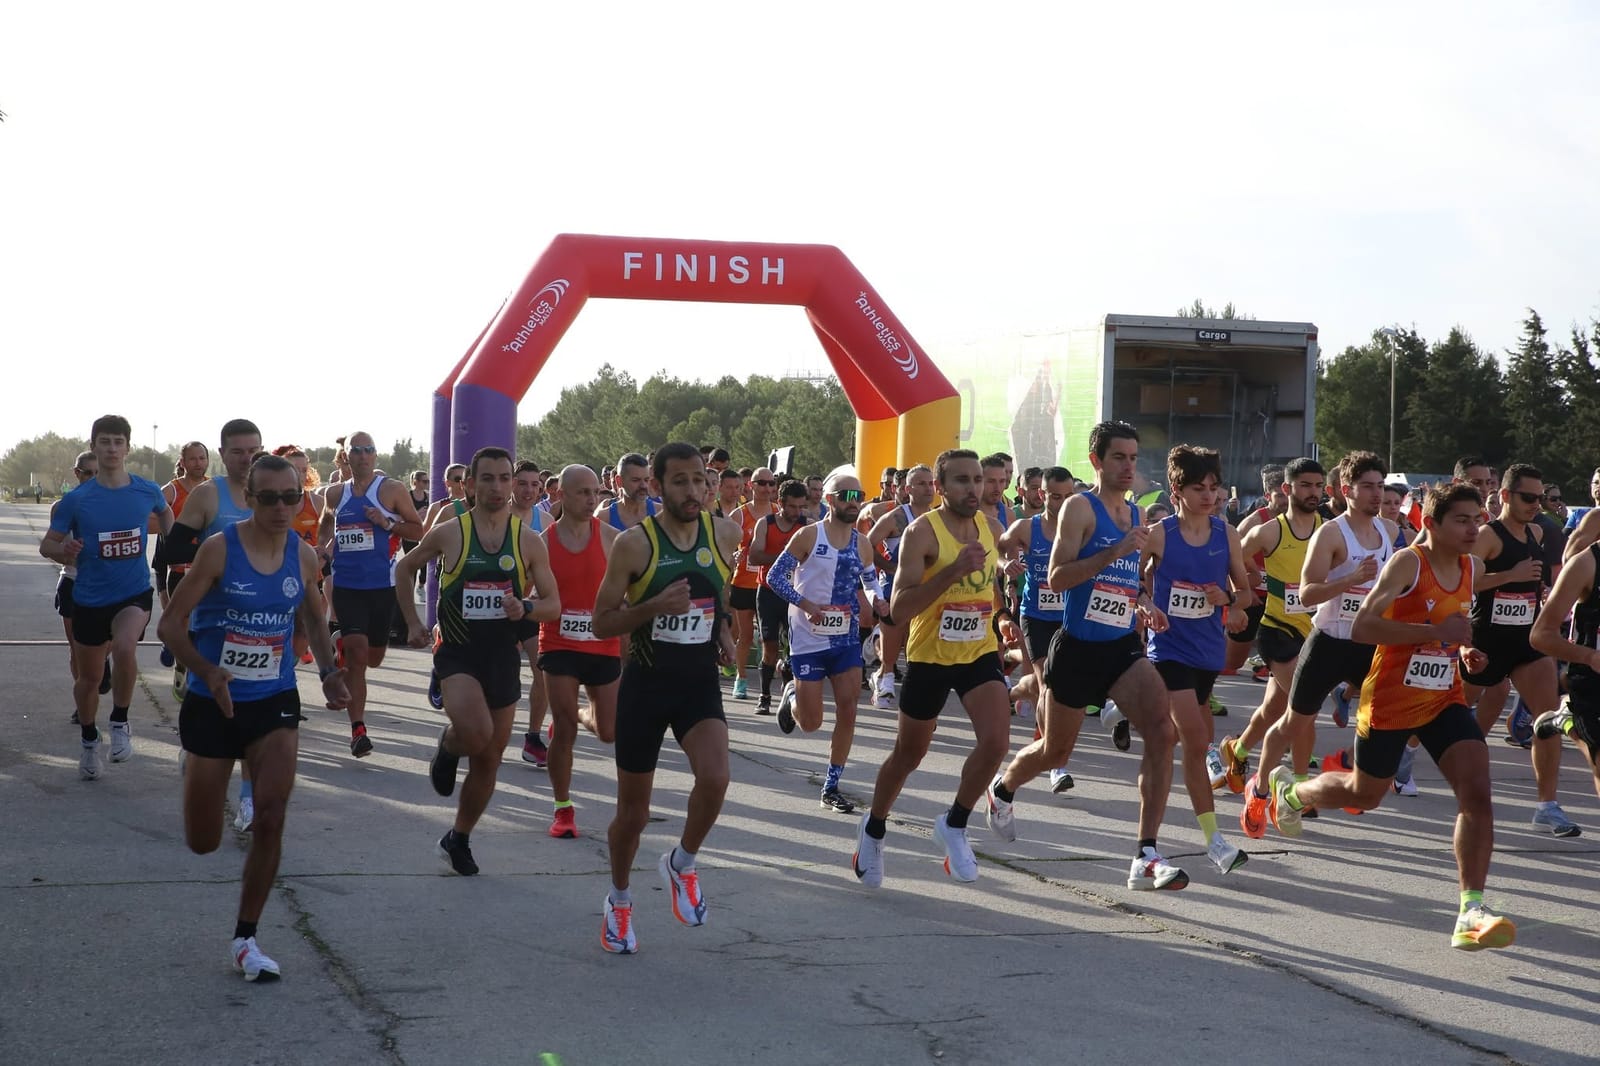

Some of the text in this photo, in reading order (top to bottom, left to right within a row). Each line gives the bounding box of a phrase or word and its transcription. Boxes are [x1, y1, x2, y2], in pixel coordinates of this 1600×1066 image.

[624, 252, 784, 285] FINISH
[538, 306, 555, 326] MALTA
[855, 297, 901, 350] Athletics
[510, 300, 549, 352] Athletics
[1199, 330, 1227, 340] Cargo
[876, 332, 895, 354] MALTA
[339, 533, 364, 544] 3196
[103, 540, 140, 558] 8155
[465, 595, 502, 609] 3018
[1091, 596, 1127, 616] 3226
[1171, 594, 1205, 609] 3173
[1495, 603, 1527, 616] 3020
[656, 615, 701, 631] 3017
[943, 616, 979, 631] 3028
[223, 649, 270, 669] 3222
[1410, 661, 1449, 679] 3007
